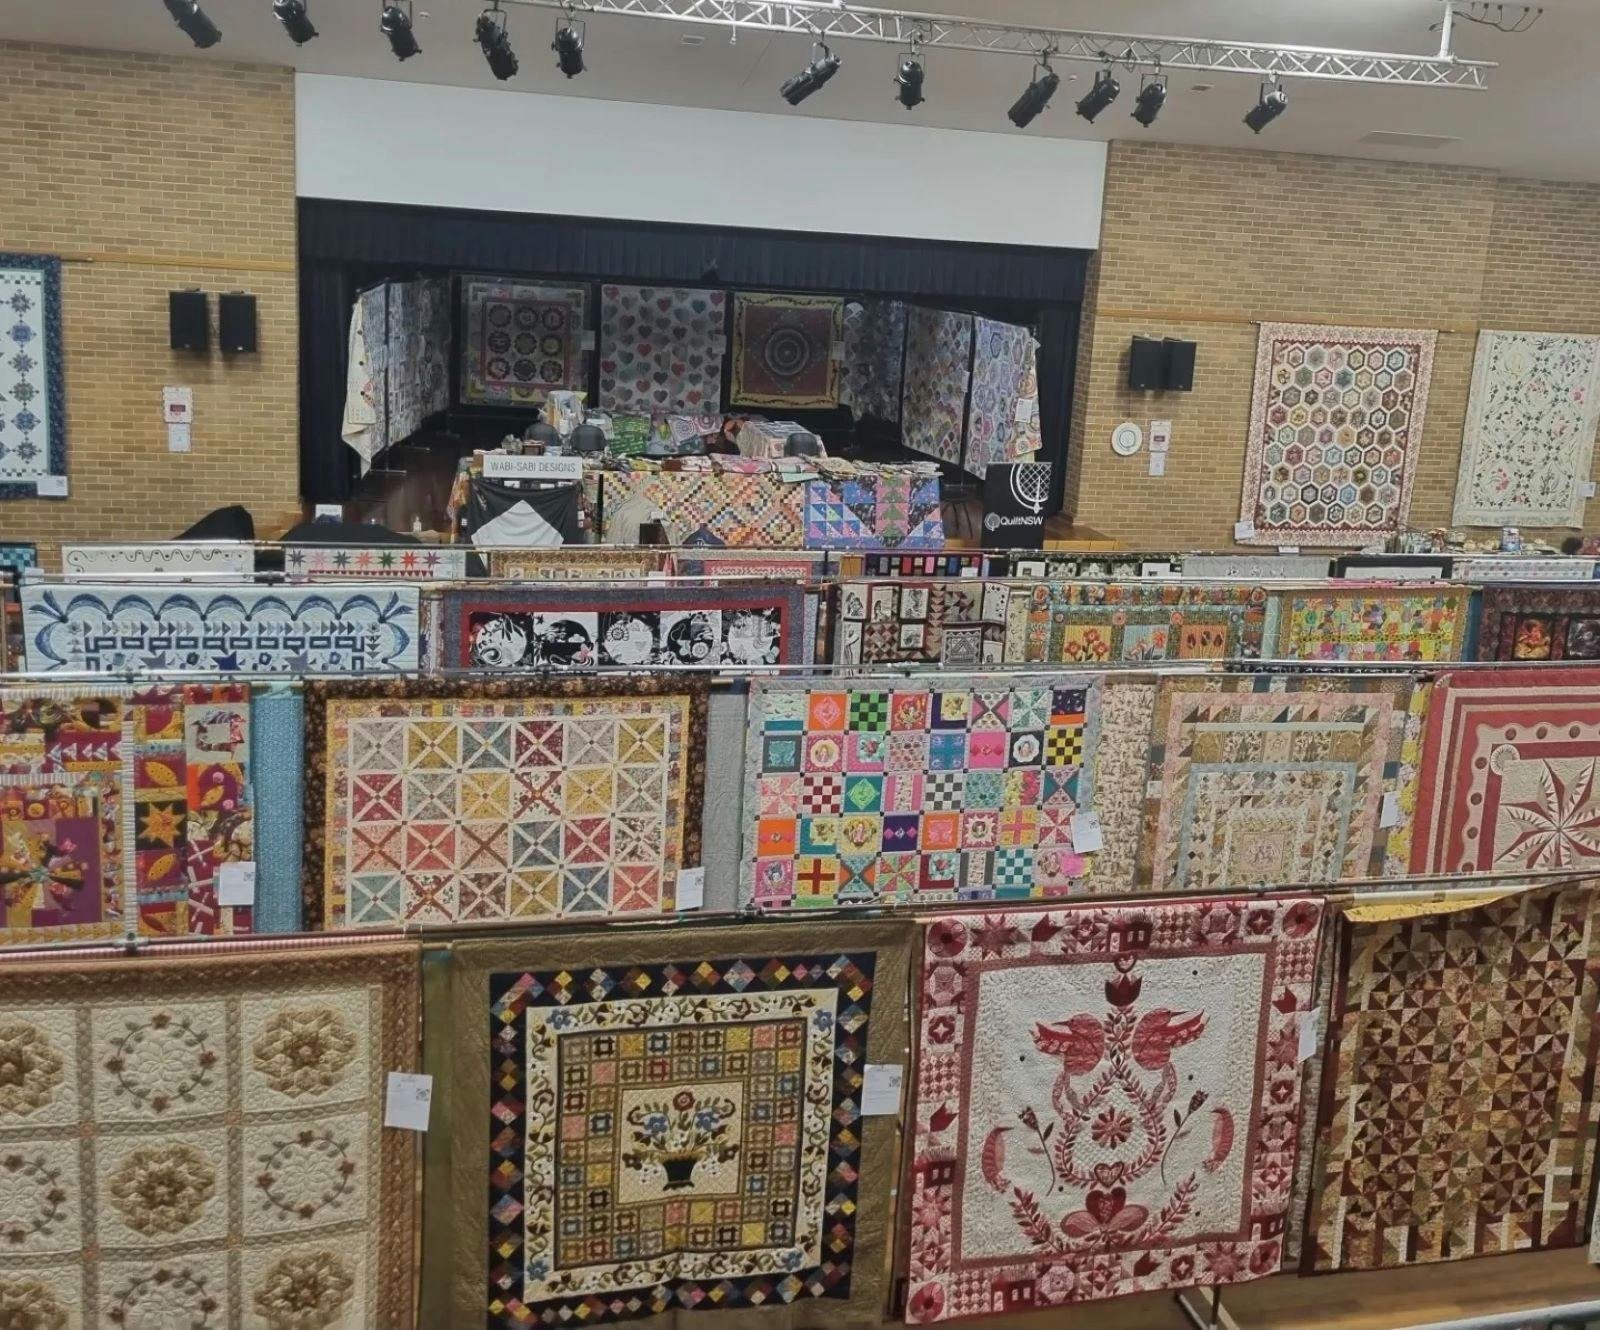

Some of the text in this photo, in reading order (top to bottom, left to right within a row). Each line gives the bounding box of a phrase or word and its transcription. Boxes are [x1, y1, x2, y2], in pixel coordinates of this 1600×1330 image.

[490, 461, 576, 473] WABI-SABI DESIGNS
[1000, 516, 1043, 526] QuiltNSW
